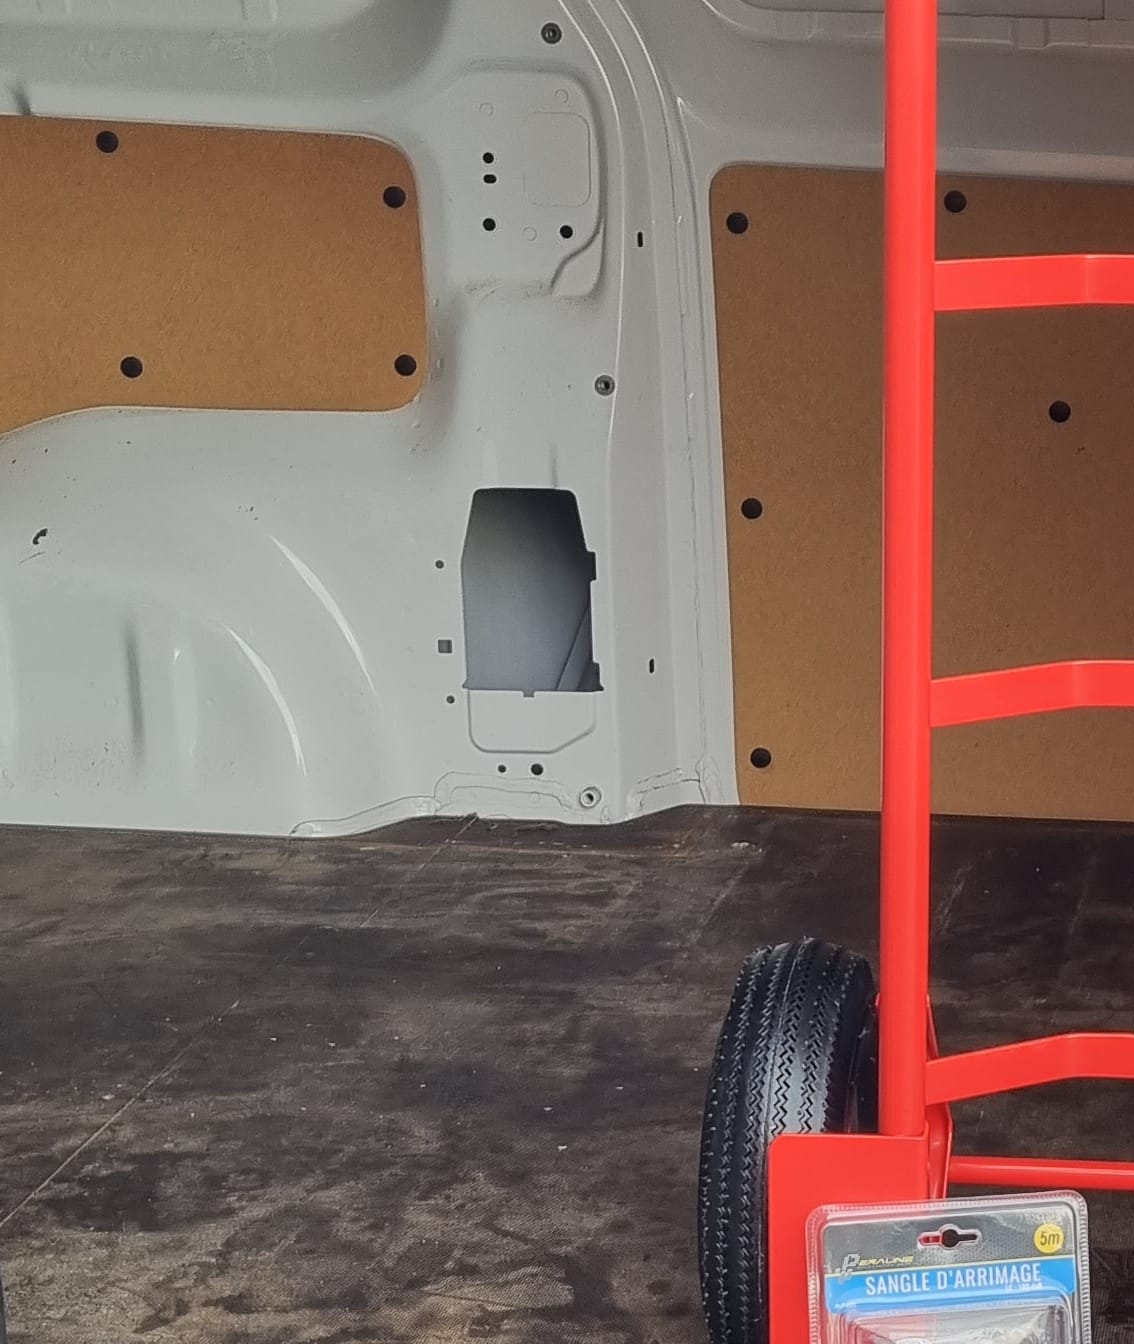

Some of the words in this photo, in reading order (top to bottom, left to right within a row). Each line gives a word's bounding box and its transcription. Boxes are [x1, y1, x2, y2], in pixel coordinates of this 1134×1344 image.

[1040, 1231, 1060, 1246] 5m
[866, 1271, 929, 1295] SANGLE
[938, 1263, 1041, 1290] D'ARRIMAGE
